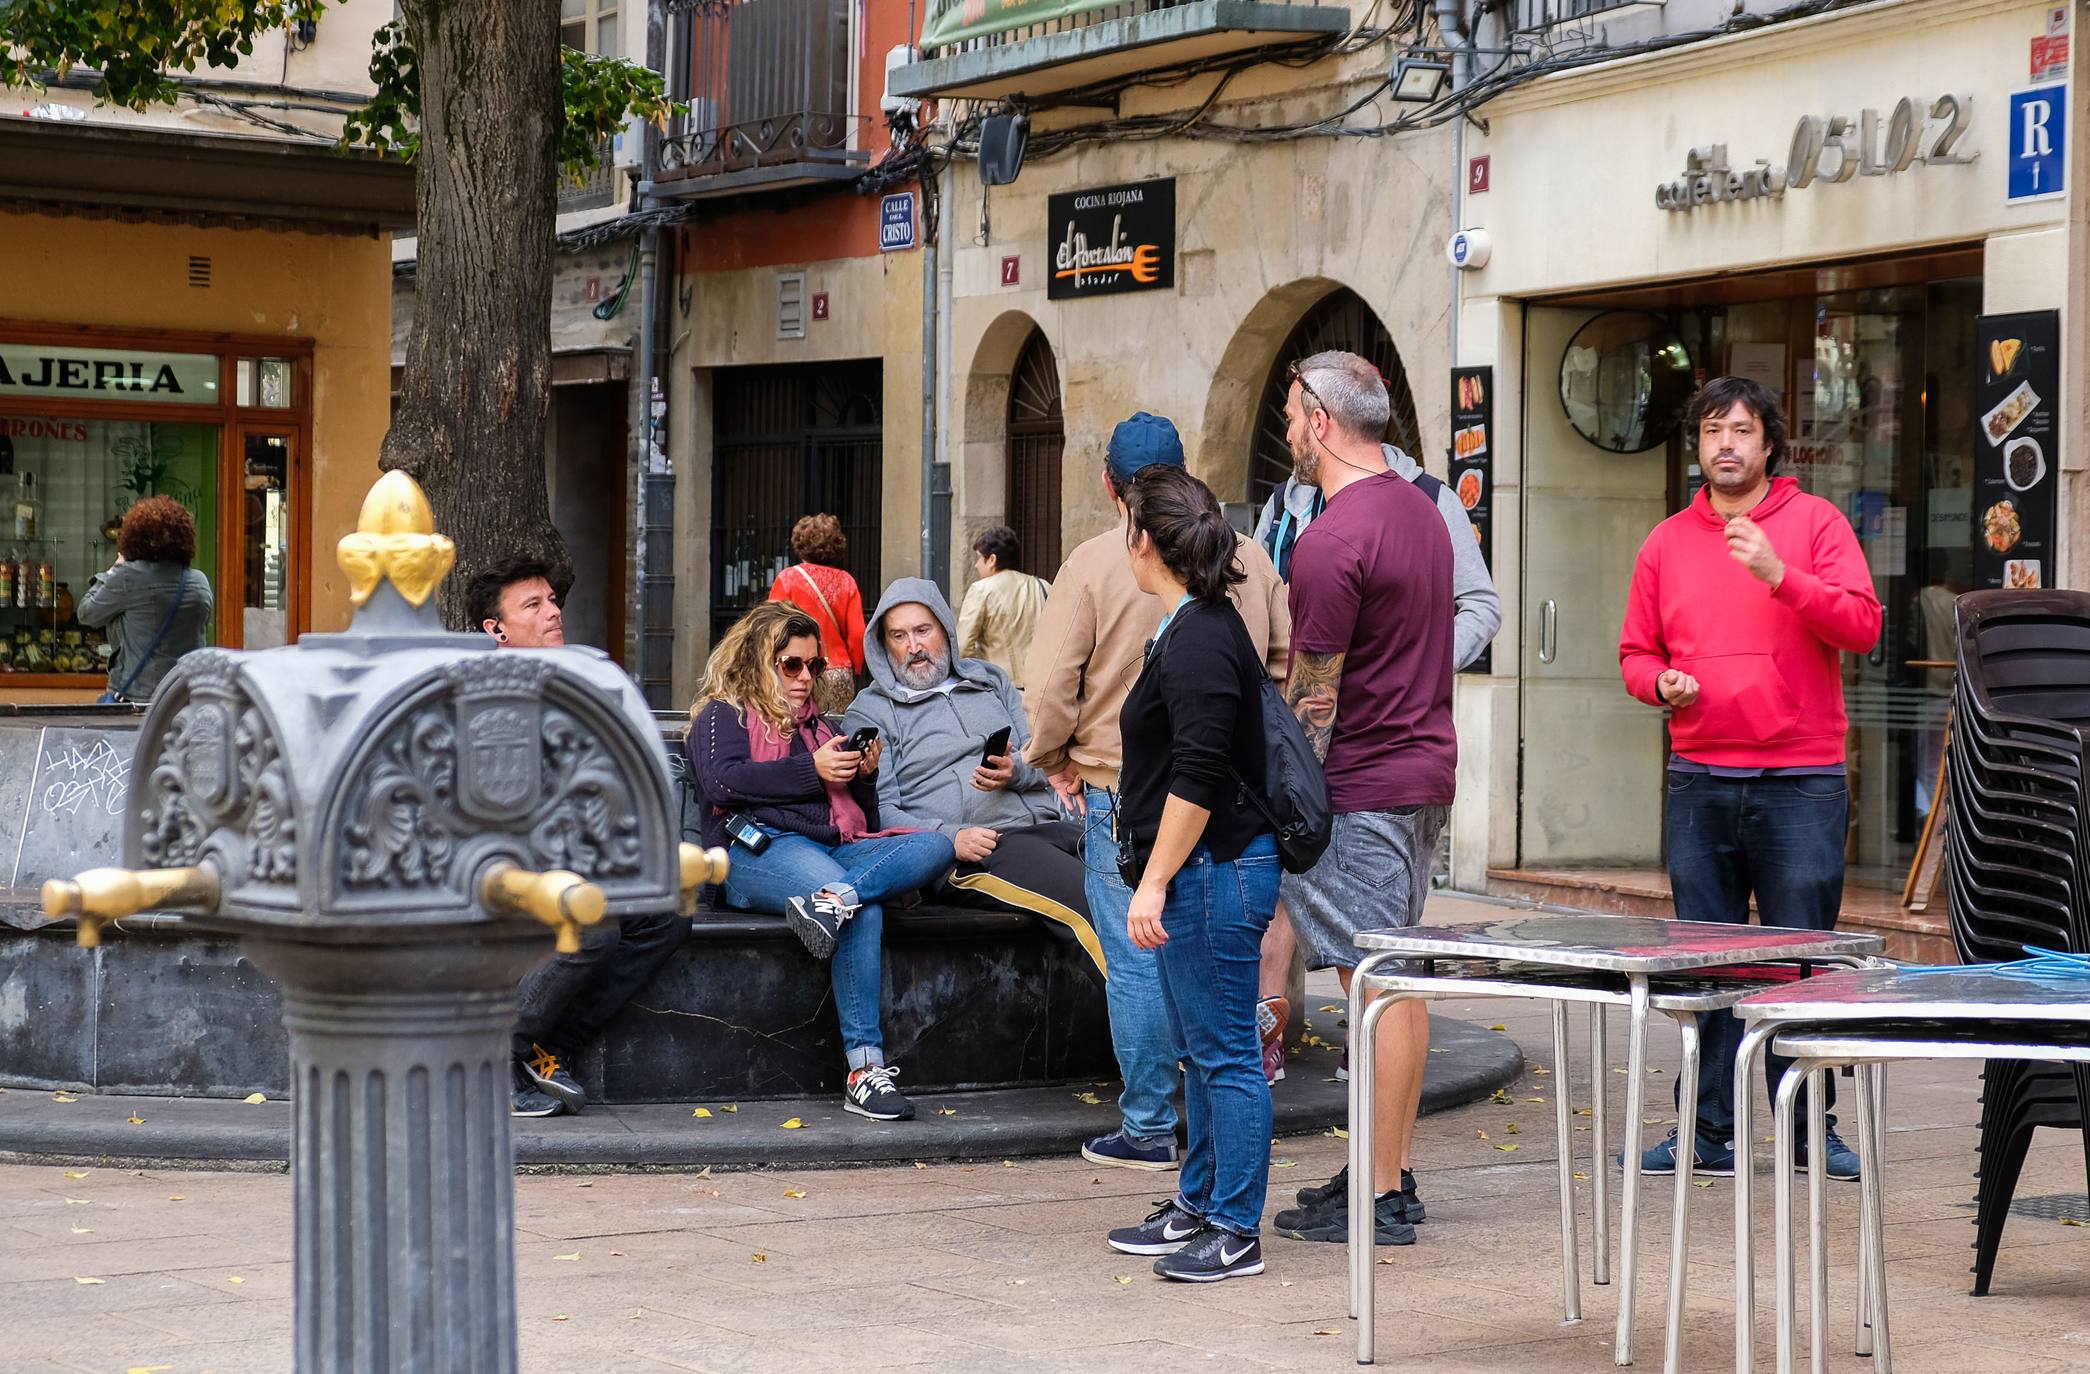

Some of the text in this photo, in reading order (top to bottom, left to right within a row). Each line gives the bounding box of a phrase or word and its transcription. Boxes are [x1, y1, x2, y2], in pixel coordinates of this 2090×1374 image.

[2020, 99, 2054, 159] R
[1473, 164, 1484, 184] 9
[885, 199, 909, 213] CALLE
[1074, 189, 1144, 210] COCINA RIOJANA
[883, 221, 910, 243] CRISTO
[1006, 262, 1014, 280] 7
[817, 298, 825, 315] 2
[855, 1084, 872, 1105] N
